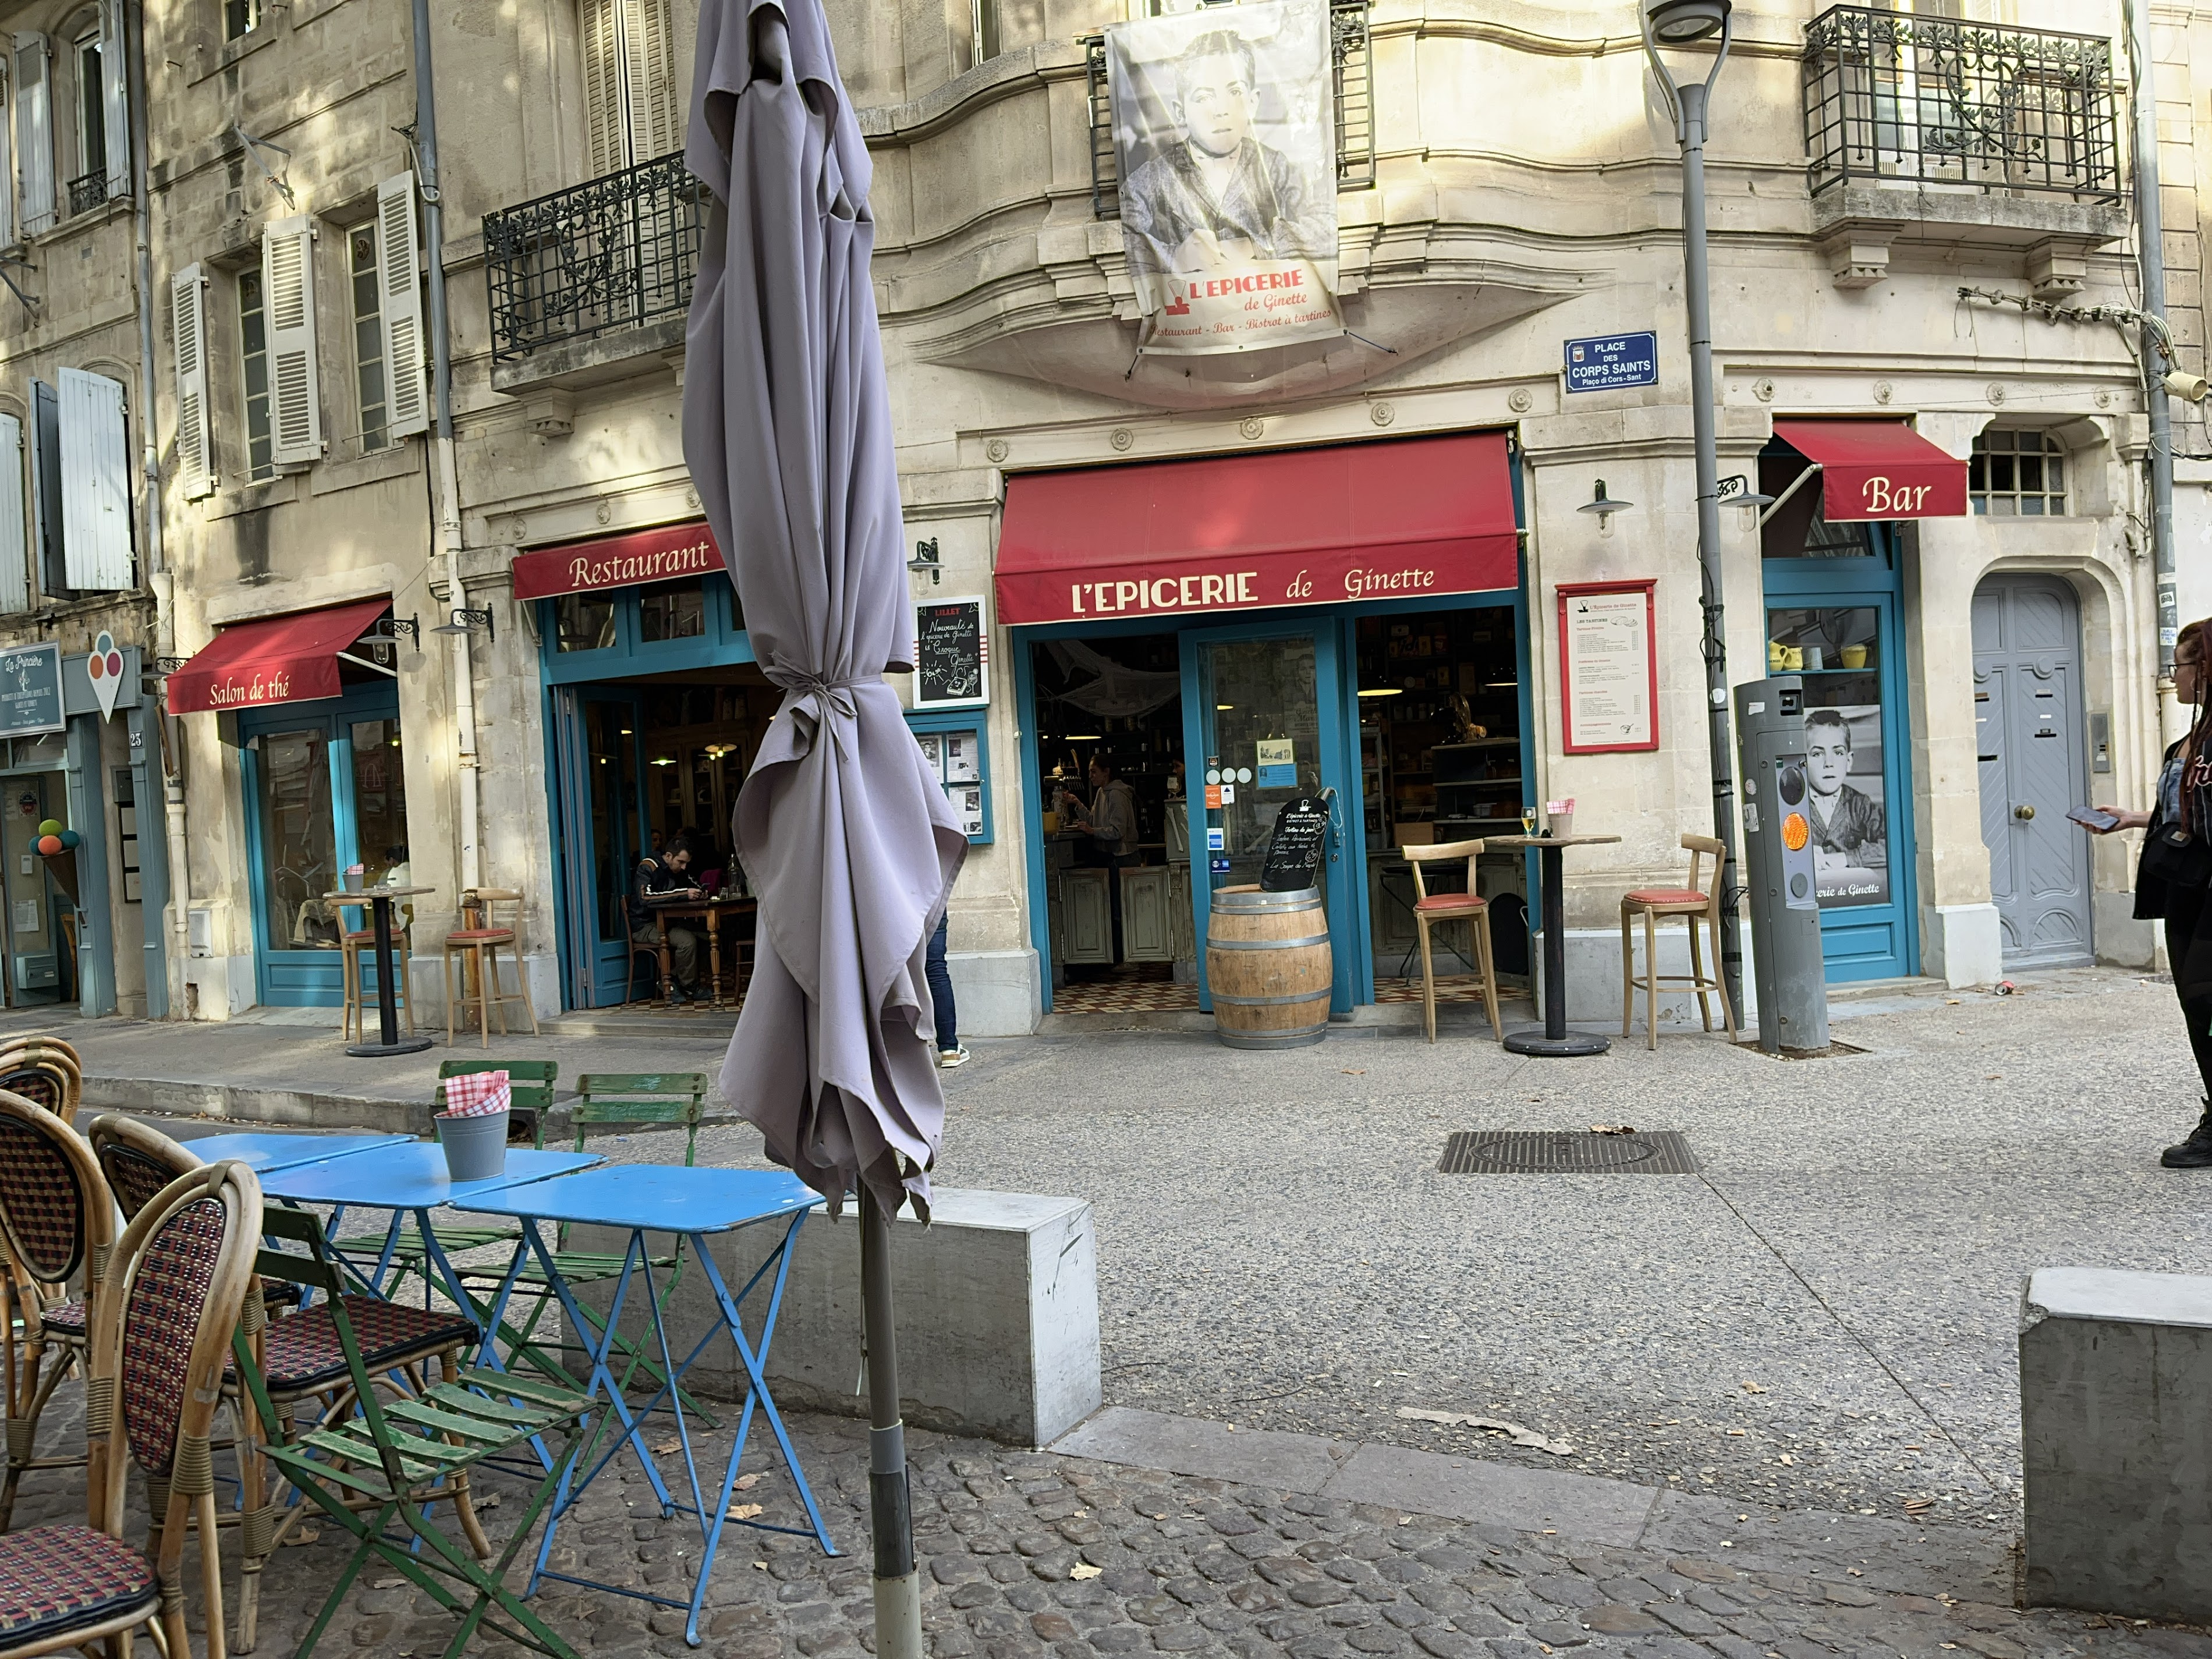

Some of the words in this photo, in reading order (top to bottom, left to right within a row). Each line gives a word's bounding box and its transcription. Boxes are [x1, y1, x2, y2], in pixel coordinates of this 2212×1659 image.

[1190, 269, 1304, 299] L'EPICERIE
[1245, 296, 1259, 311] de
[1264, 293, 1308, 313] Ginette
[1150, 325, 1202, 337] Restaurant
[1213, 322, 1235, 334] Bar
[1246, 316, 1282, 330] Bistrot
[1285, 314, 1292, 325] à
[1294, 310, 1332, 324] tartines
[1594, 342, 1626, 353] PLACE
[1572, 364, 1609, 378] CORPS
[1612, 360, 1651, 374] SAINTS
[1582, 378, 1600, 387] Plaço
[1863, 476, 1932, 512] Bar
[569, 541, 710, 587] Restaurant
[1072, 572, 1259, 613] L'EPICERIE
[1286, 569, 1312, 598] de
[1345, 568, 1434, 600] Ginette
[935, 607, 961, 617] LILLET
[929, 619, 966, 634] Nouveauté
[952, 630, 973, 644] Ginette
[933, 640, 960, 658] Croque
[951, 653, 974, 677] Ginette
[210, 677, 246, 705] Salon
[249, 673, 264, 700] de
[268, 671, 289, 699] thé
[130, 733, 141, 746] 23
[1837, 887, 1847, 896] de
[1848, 883, 1880, 898] Ginette
